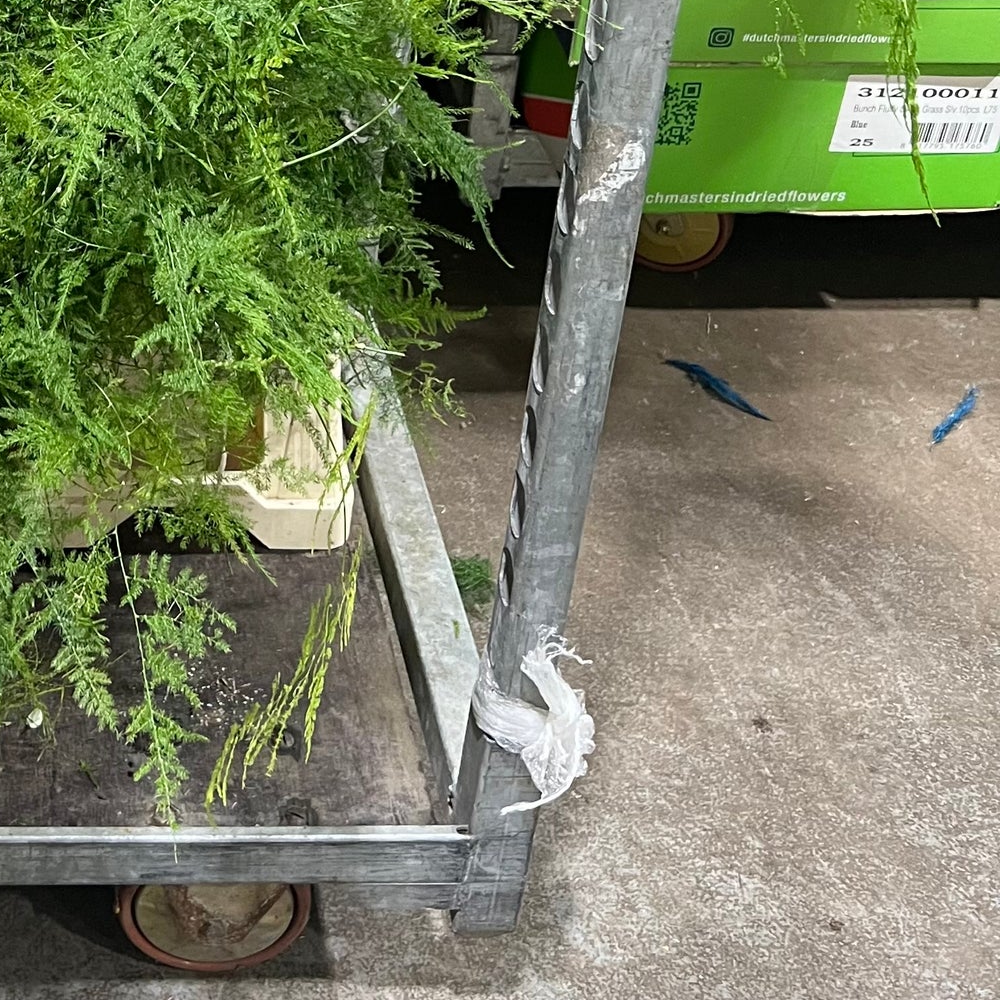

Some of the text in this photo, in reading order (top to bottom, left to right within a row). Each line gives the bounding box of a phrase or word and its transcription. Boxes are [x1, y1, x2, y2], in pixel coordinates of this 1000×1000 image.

[857, 87, 998, 98] 31200011
[853, 104, 877, 113] Bunch
[922, 104, 943, 113] Grass
[850, 120, 868, 129] Blue
[850, 138, 874, 147] 25
